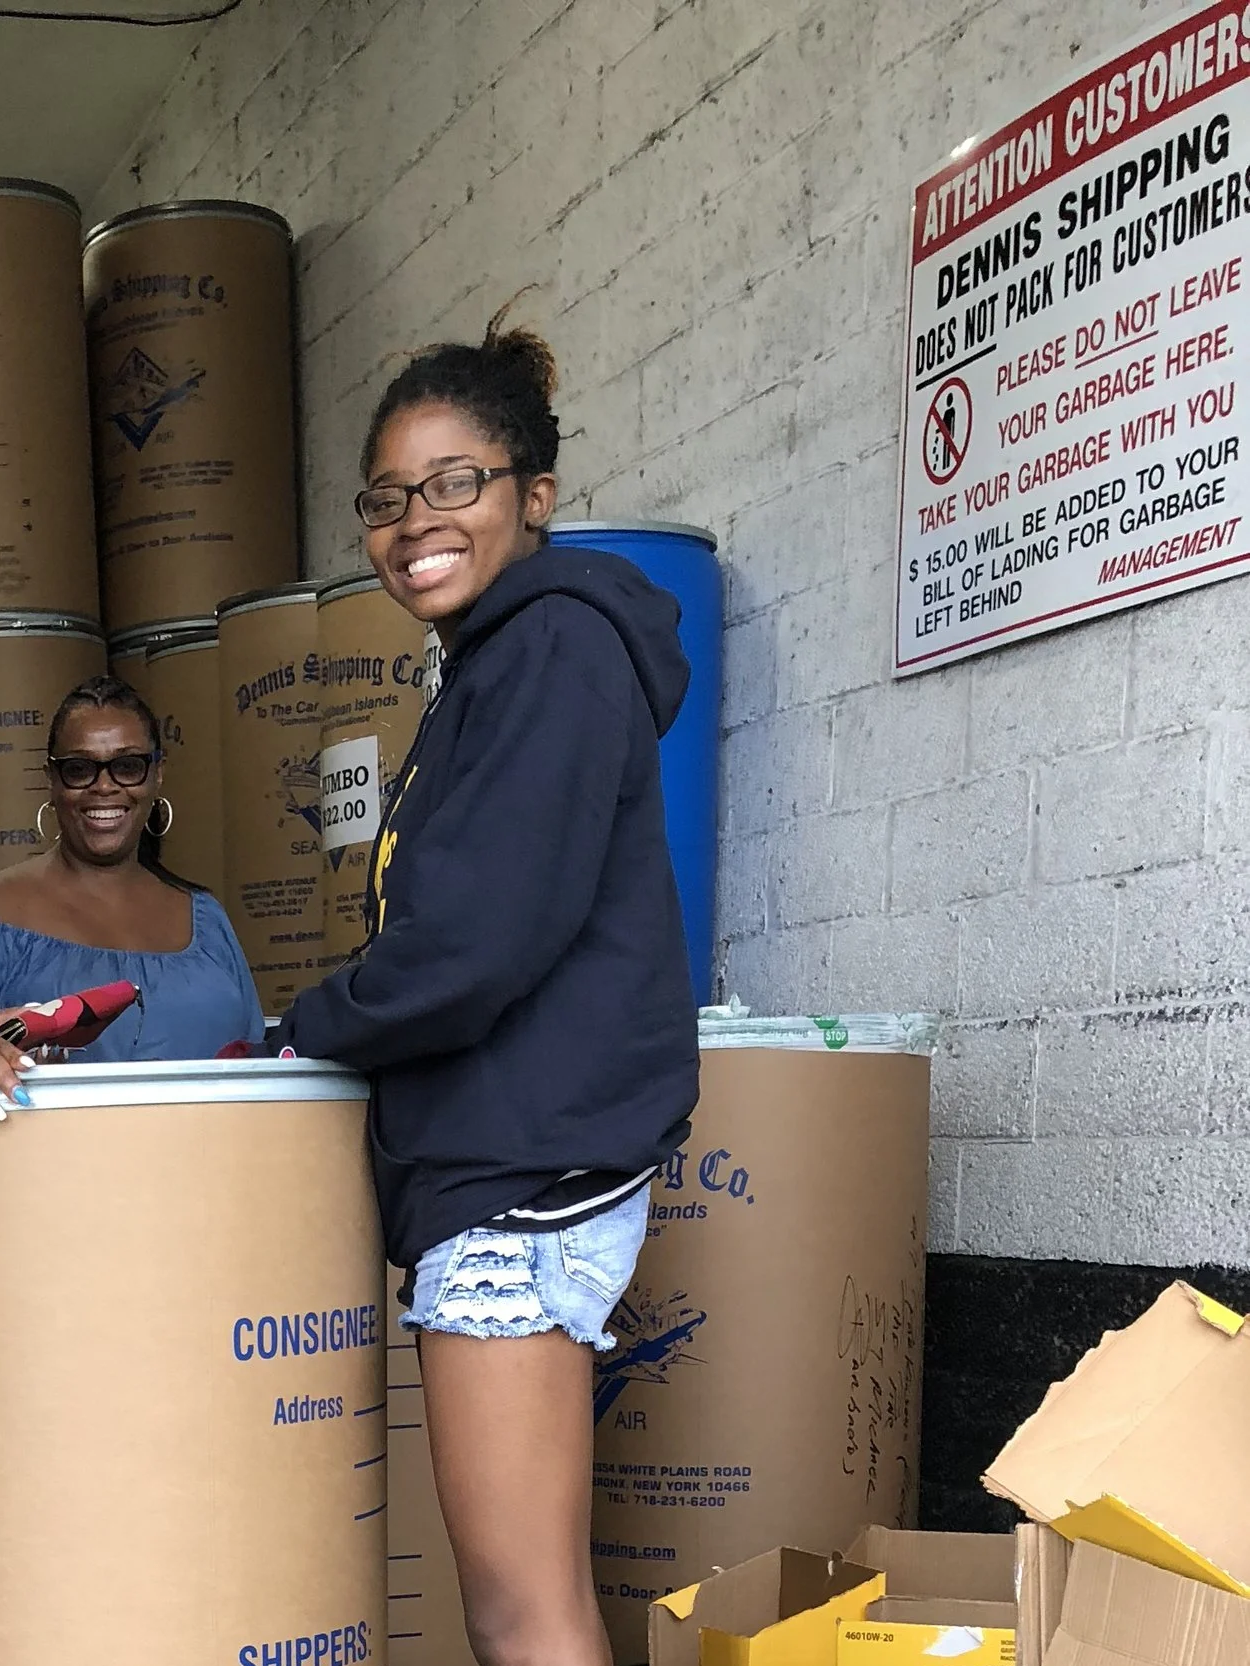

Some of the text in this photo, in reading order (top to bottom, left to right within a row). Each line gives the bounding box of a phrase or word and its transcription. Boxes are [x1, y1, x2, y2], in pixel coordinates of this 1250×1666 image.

[922, 113, 1054, 248] ATTENTION
[937, 112, 1231, 310] DENNIS SHIPPING
[916, 316, 956, 377] DOES
[964, 292, 998, 351] NOT
[1005, 261, 1055, 328] PACK
[1064, 238, 1102, 299] FOR
[997, 256, 1242, 397] PLEASE DO NOT LEAVE
[998, 324, 1235, 449] YOUR GARBAGE HERE.
[918, 381, 1235, 536] TAKE YOUR GARBAGE WITH YOU
[925, 539, 967, 576] 15.00
[974, 521, 1014, 556] WILL
[1022, 507, 1047, 538] BE
[1055, 477, 1126, 526] ADDED
[1136, 463, 1165, 495] TO
[1175, 435, 1240, 481] YOUR
[922, 477, 1226, 607] BILL OF LADING FOR GARBAGE
[1097, 516, 1243, 586] MANAGEMENT
[915, 579, 1022, 638] LEFT BEHIND
[270, 703, 292, 716] The
[354, 693, 399, 712] Islands
[290, 840, 320, 856] SEA
[347, 851, 366, 867] AIR
[826, 1030, 846, 1043] STOP
[699, 1148, 755, 1206] Co.
[648, 1201, 708, 1221] lands
[232, 1303, 380, 1363] CONSIGNEE:
[273, 1394, 344, 1426] Address
[614, 1410, 647, 1431] AIR
[618, 1464, 656, 1476] WHITE
[660, 1465, 709, 1477] PLAINS
[714, 1466, 752, 1477] ROAD
[633, 1480, 662, 1492] NEW
[666, 1481, 701, 1493] YORK
[707, 1482, 750, 1493] 10466
[634, 1494, 726, 1507] 718-231-6200
[845, 1631, 894, 1642] 46010W-20
